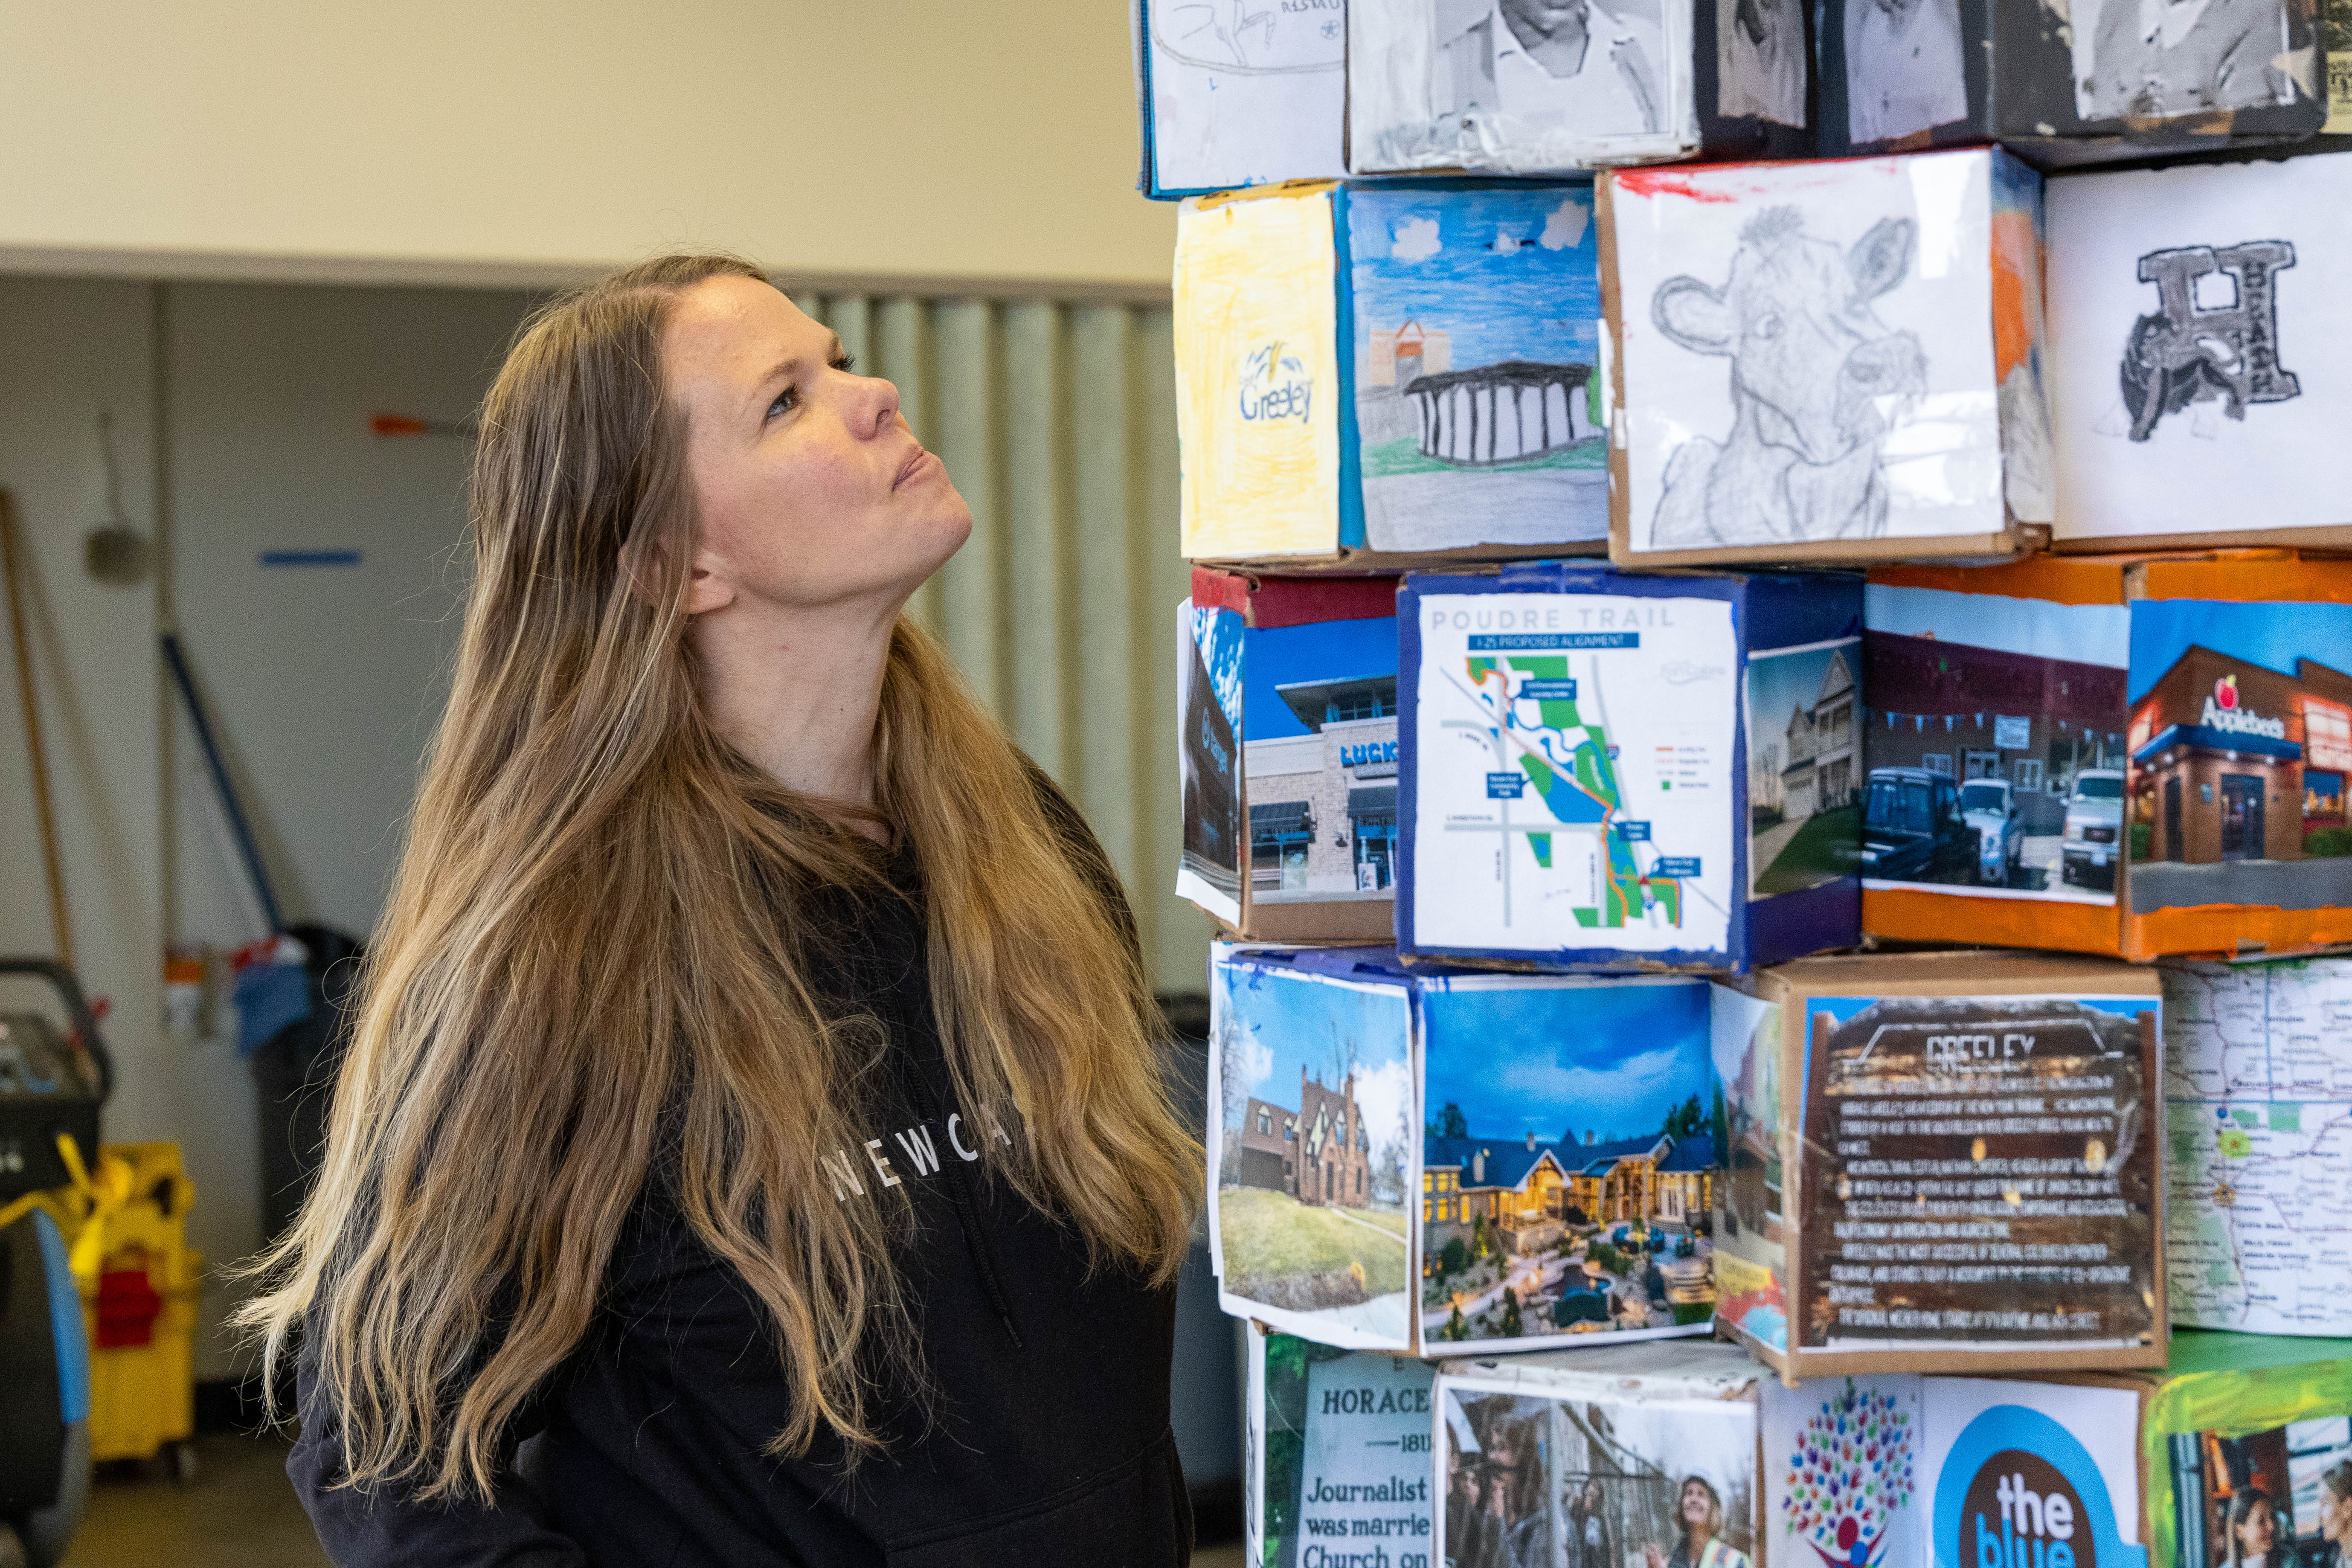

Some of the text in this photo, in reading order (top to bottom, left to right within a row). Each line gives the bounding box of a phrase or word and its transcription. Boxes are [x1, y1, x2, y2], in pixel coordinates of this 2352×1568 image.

[1240, 379, 1312, 424] Greeley
[1432, 607, 1675, 630] POUDRE TRAIL
[1499, 635, 1559, 648] PROPOSED
[1561, 633, 1624, 647] ALIGNMENT
[1926, 1034, 2035, 1072] GREELEY
[1322, 1388, 1431, 1414] HORACE
[1307, 1476, 1427, 1503] Journalist
[1996, 1472, 2074, 1539] the
[1305, 1513, 1430, 1536] was marrie
[1976, 1511, 2076, 1568] blue
[1303, 1545, 1427, 1568] Church on
